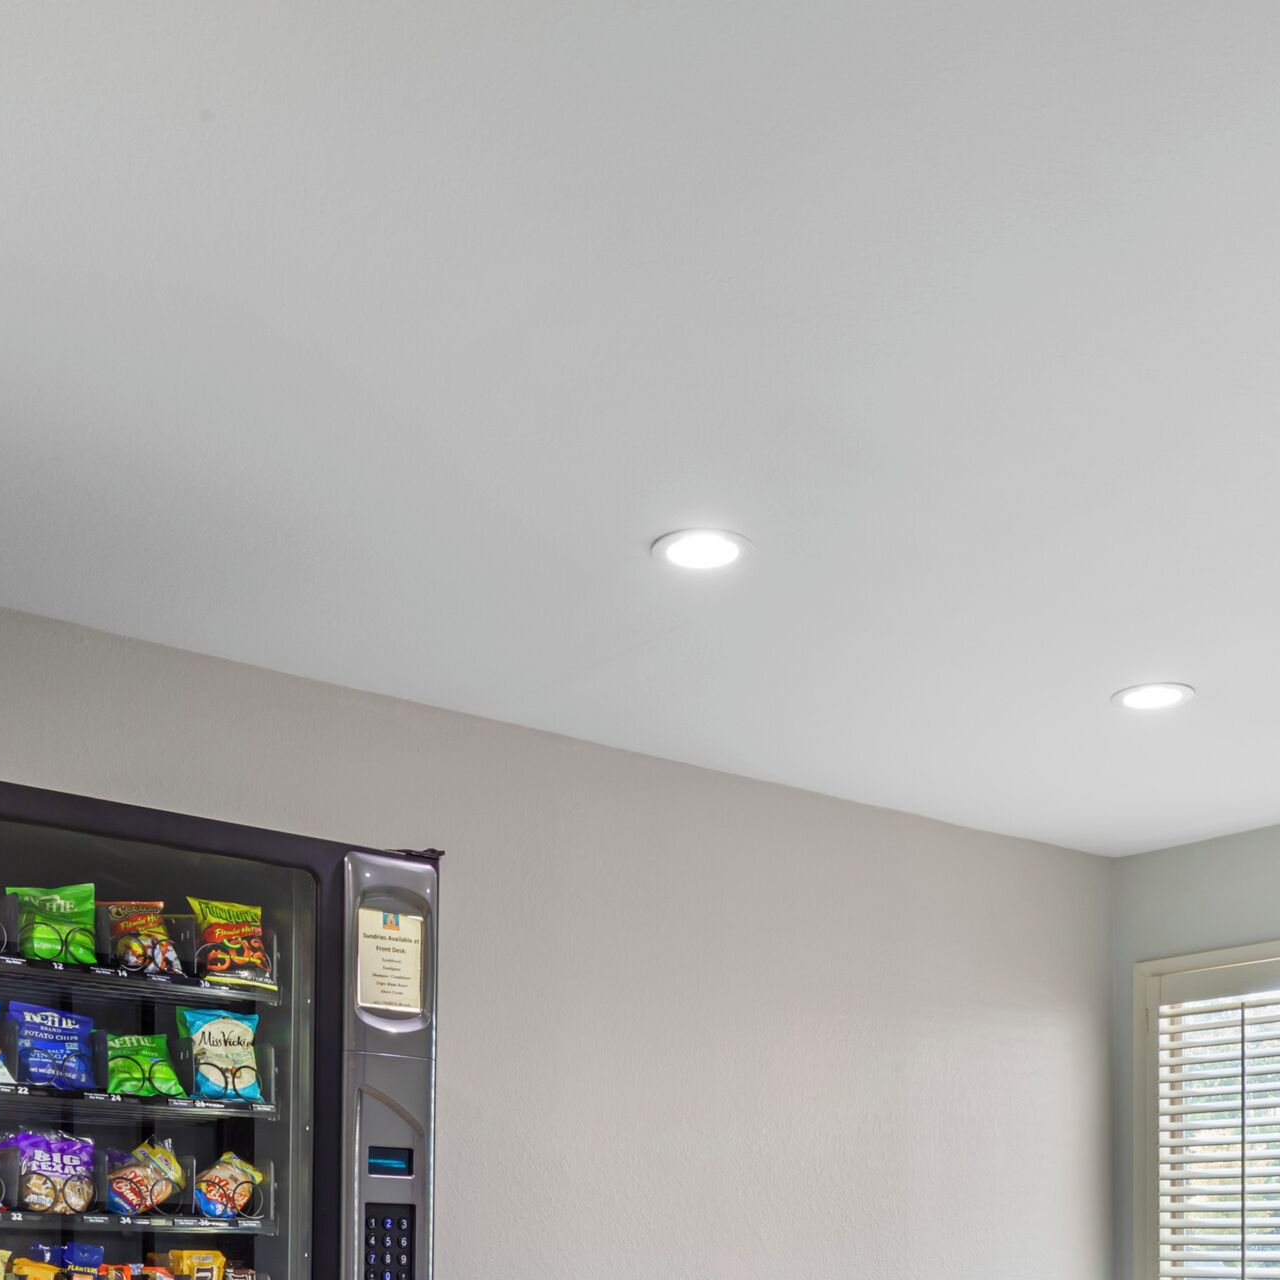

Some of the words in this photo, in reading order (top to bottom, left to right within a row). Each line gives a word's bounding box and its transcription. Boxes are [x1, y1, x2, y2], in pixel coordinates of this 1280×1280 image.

[376, 945, 390, 953] Front
[53, 962, 64, 970] 12
[117, 970, 127, 978] 14
[24, 1030, 54, 1040] POTATO
[199, 1030, 222, 1047] Miss
[17, 1087, 29, 1095] 22
[34, 1150, 81, 1165] BIG
[30, 1160, 86, 1176] TEXAS
[12, 1213, 23, 1221] 32
[370, 1219, 375, 1228] 1
[386, 1219, 391, 1228] 2
[402, 1219, 407, 1229] 3
[370, 1237, 375, 1245] 4
[386, 1237, 391, 1246] 5
[401, 1237, 407, 1246] 6
[371, 1255, 375, 1263] 7
[386, 1255, 391, 1263] 8
[401, 1255, 406, 1264] 9
[68, 1264, 99, 1274] PLANTERS
[385, 1272, 391, 1280] 0
